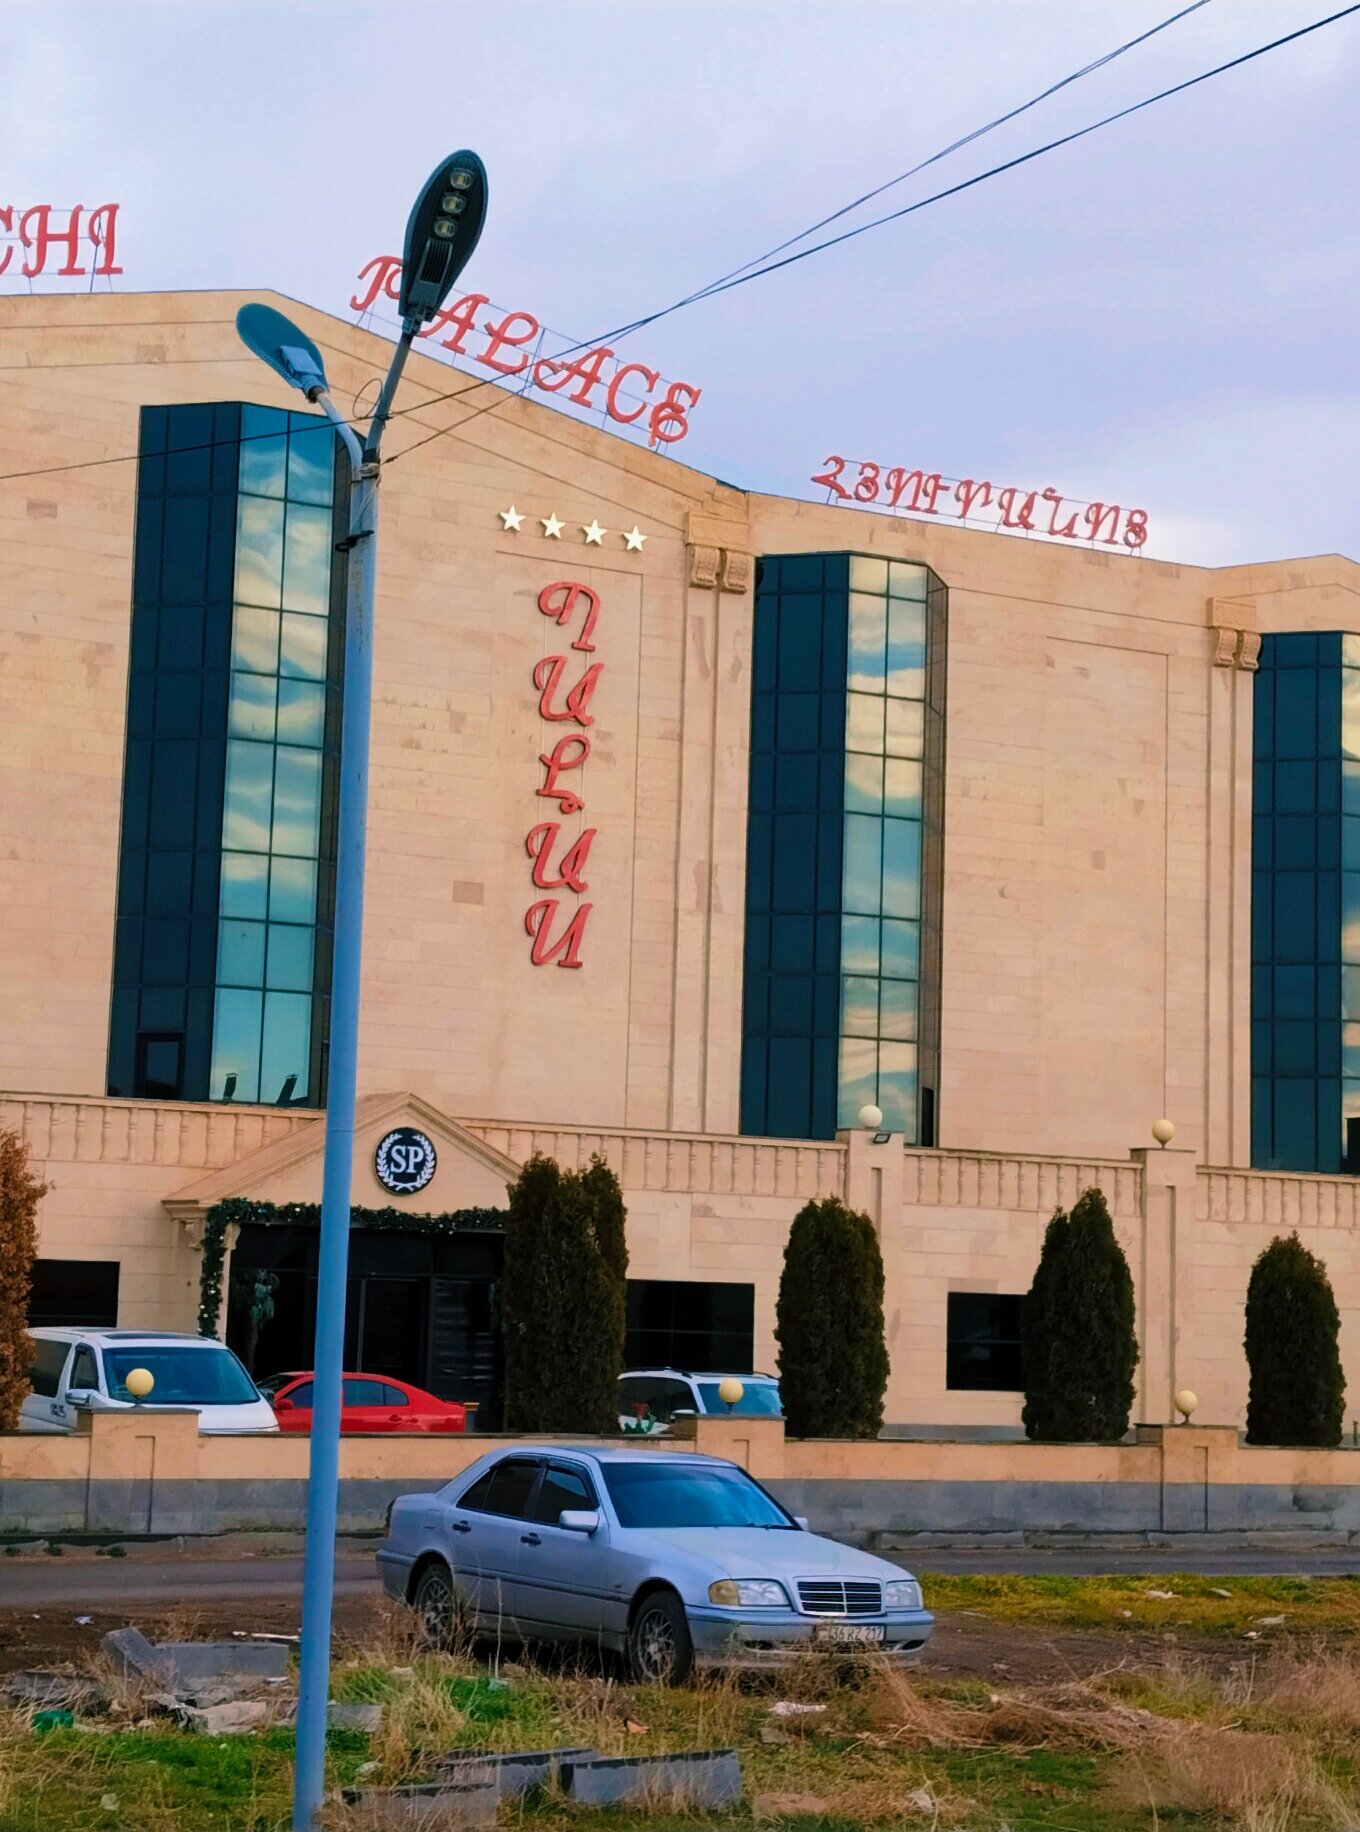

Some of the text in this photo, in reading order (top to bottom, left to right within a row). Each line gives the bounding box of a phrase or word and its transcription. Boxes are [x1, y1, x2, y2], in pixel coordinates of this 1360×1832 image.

[350, 255, 701, 447] PALACE
[810, 455, 1148, 549] ՀՅՈՒՐԱՆՈՑ
[524, 580, 605, 970] ՊԱԼԱՍ
[390, 1144, 424, 1174] SP
